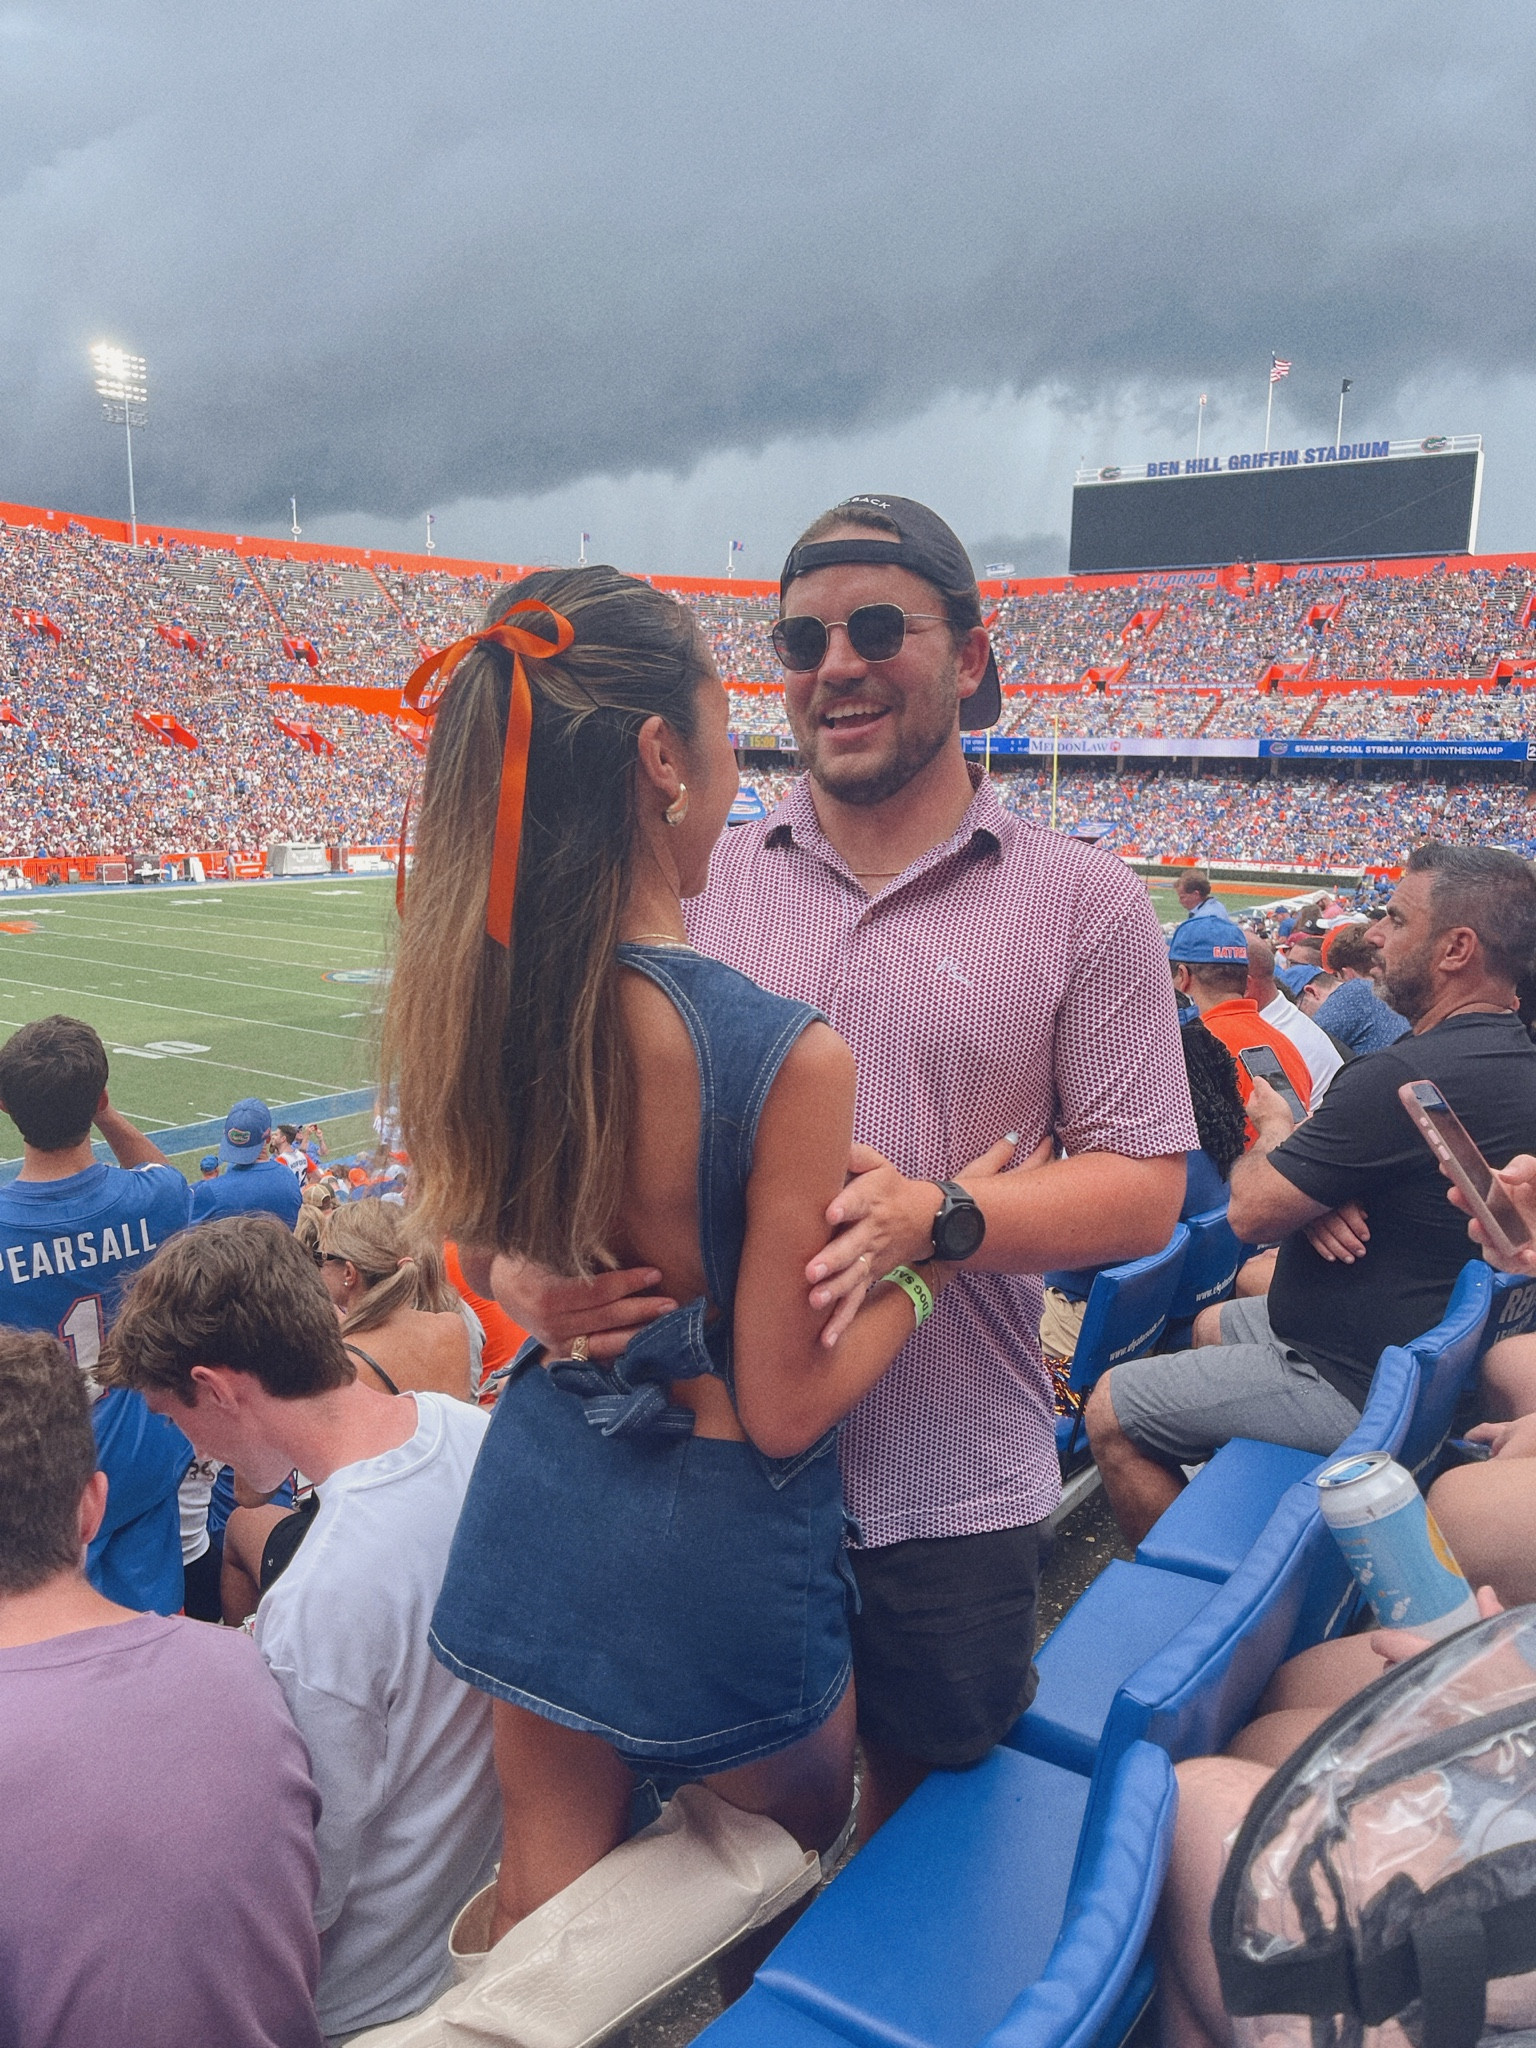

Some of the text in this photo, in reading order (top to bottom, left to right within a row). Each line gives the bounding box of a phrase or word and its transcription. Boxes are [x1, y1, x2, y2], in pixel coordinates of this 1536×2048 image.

[1146, 441, 1389, 478] BEN HILL GRIFFIN STADIUM
[1148, 573, 1217, 586] FLORIDA
[1296, 566, 1366, 580] GATORS
[1295, 745, 1329, 754] SWAMP
[1330, 745, 1363, 754] SOCIAL
[1365, 745, 1403, 754] STREAM
[0, 1218, 157, 1284] EARSALL
